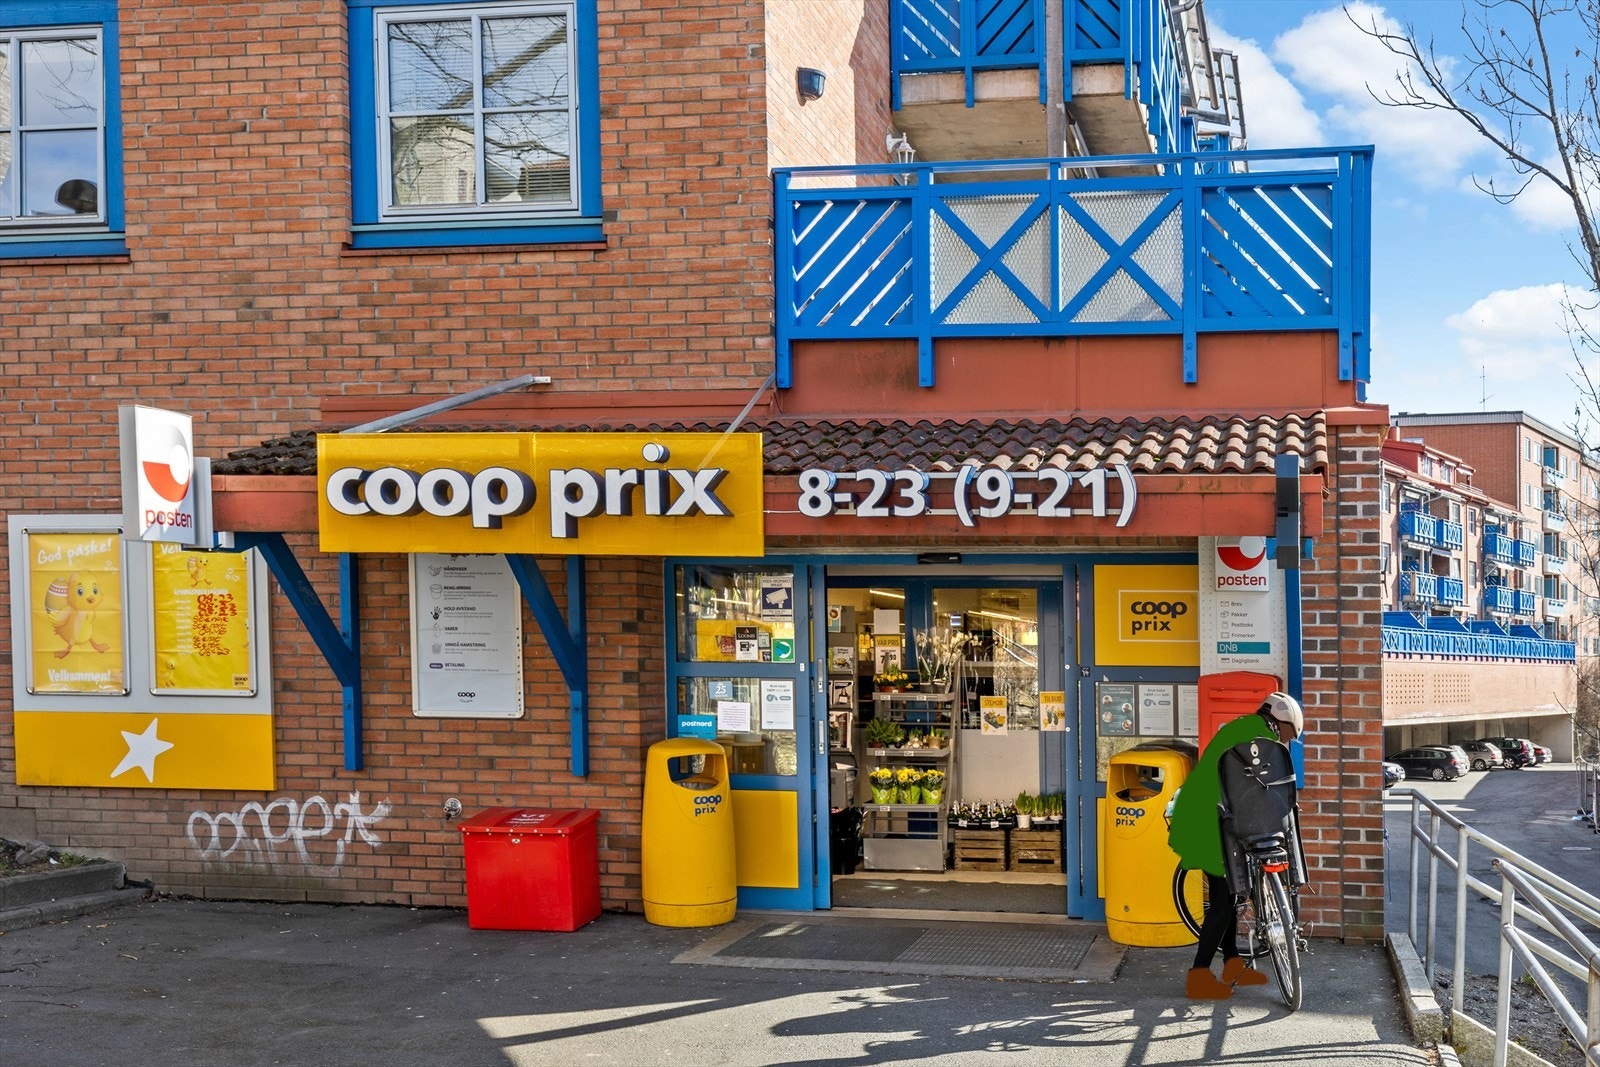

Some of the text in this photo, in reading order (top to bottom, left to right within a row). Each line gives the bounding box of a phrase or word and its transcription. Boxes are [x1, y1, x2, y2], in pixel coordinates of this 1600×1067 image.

[326, 442, 734, 539] coop prix
[797, 464, 1137, 528] 8-23 (9-21)
[145, 508, 193, 529] posten
[37, 545, 62, 565] God
[1217, 573, 1267, 589] posten
[1130, 601, 1188, 619] coop
[1131, 616, 1172, 635] prix
[1219, 643, 1238, 654] DNB
[48, 668, 111, 683] Velkommen!
[693, 794, 722, 805] coop
[695, 804, 716, 817] prix
[1116, 806, 1146, 818] coop
[1116, 816, 1135, 828] prix
